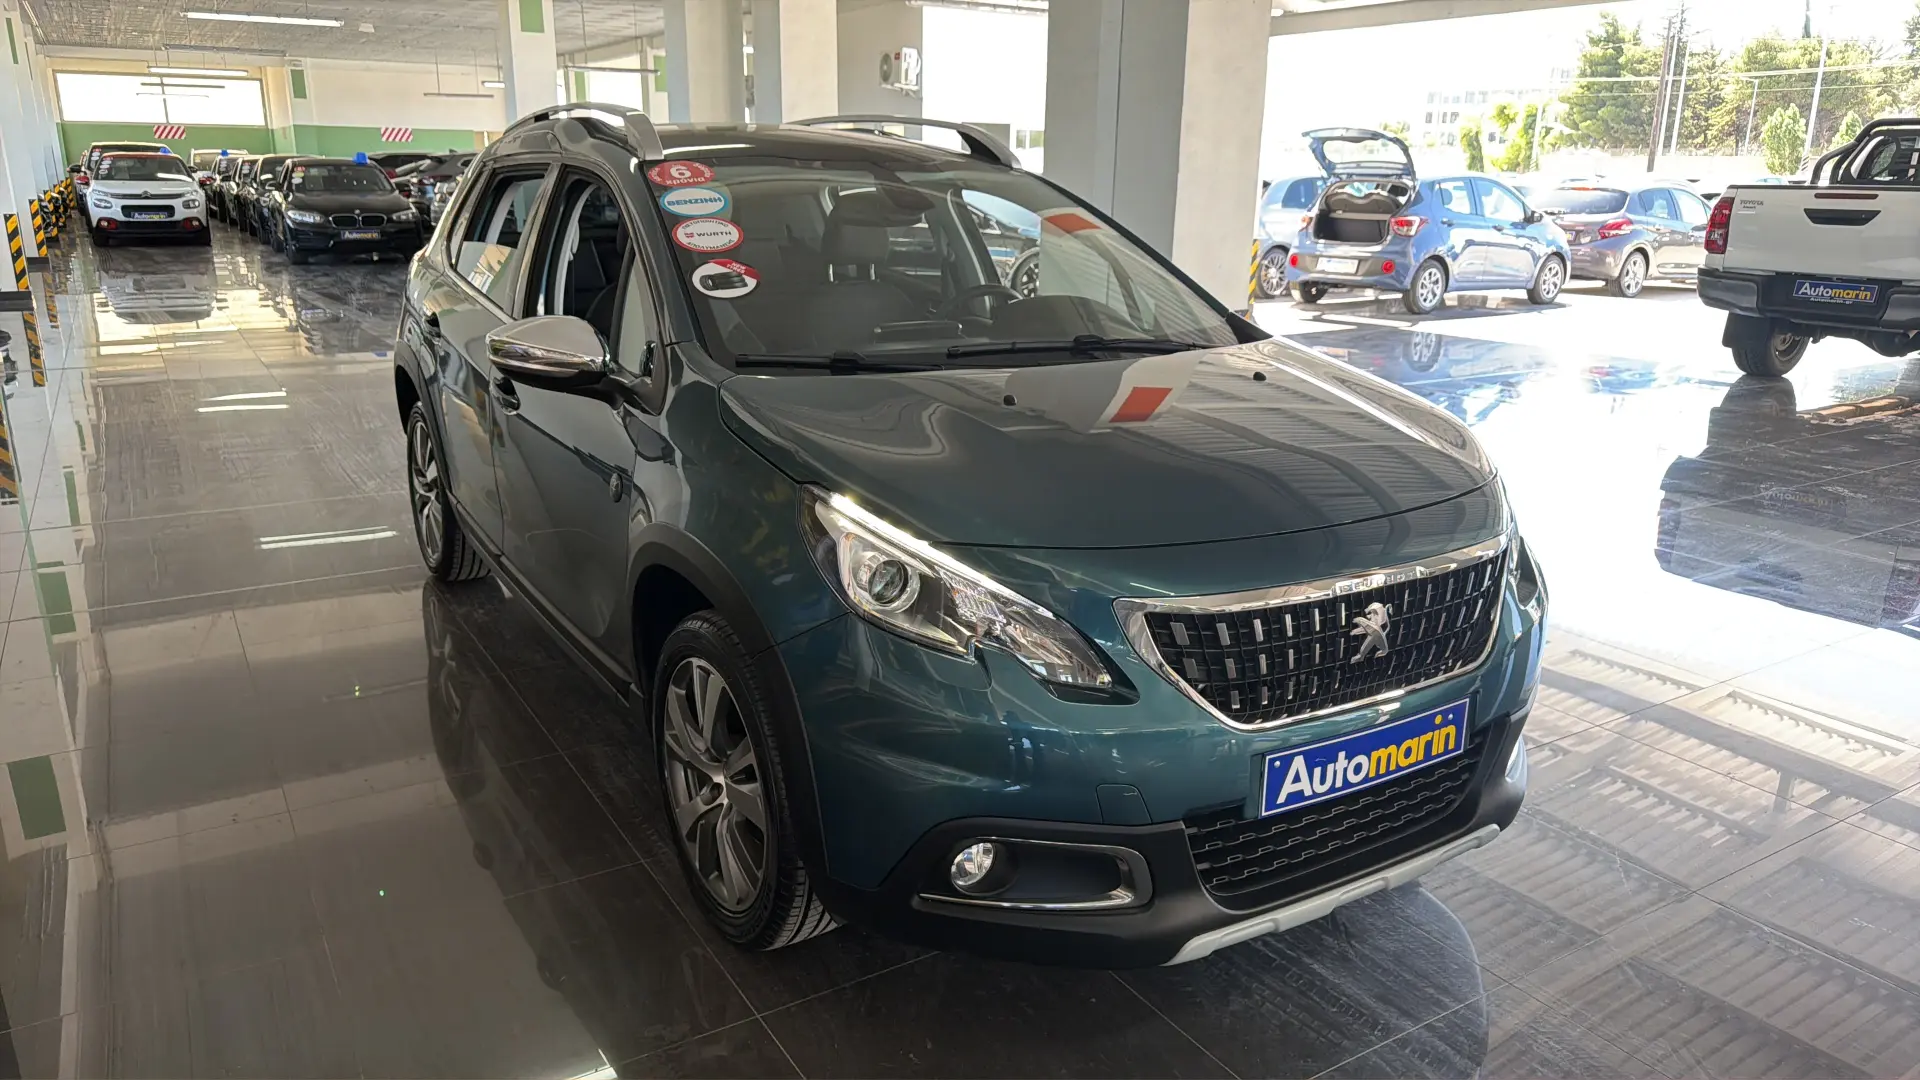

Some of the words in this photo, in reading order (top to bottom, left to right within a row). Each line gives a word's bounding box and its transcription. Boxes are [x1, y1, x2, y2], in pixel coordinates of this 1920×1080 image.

[670, 164, 692, 179] 6
[667, 197, 722, 206] ΒΕΝΖΙΝΗ
[1799, 282, 1871, 301] Automarin
[1276, 714, 1456, 805] Automarin
